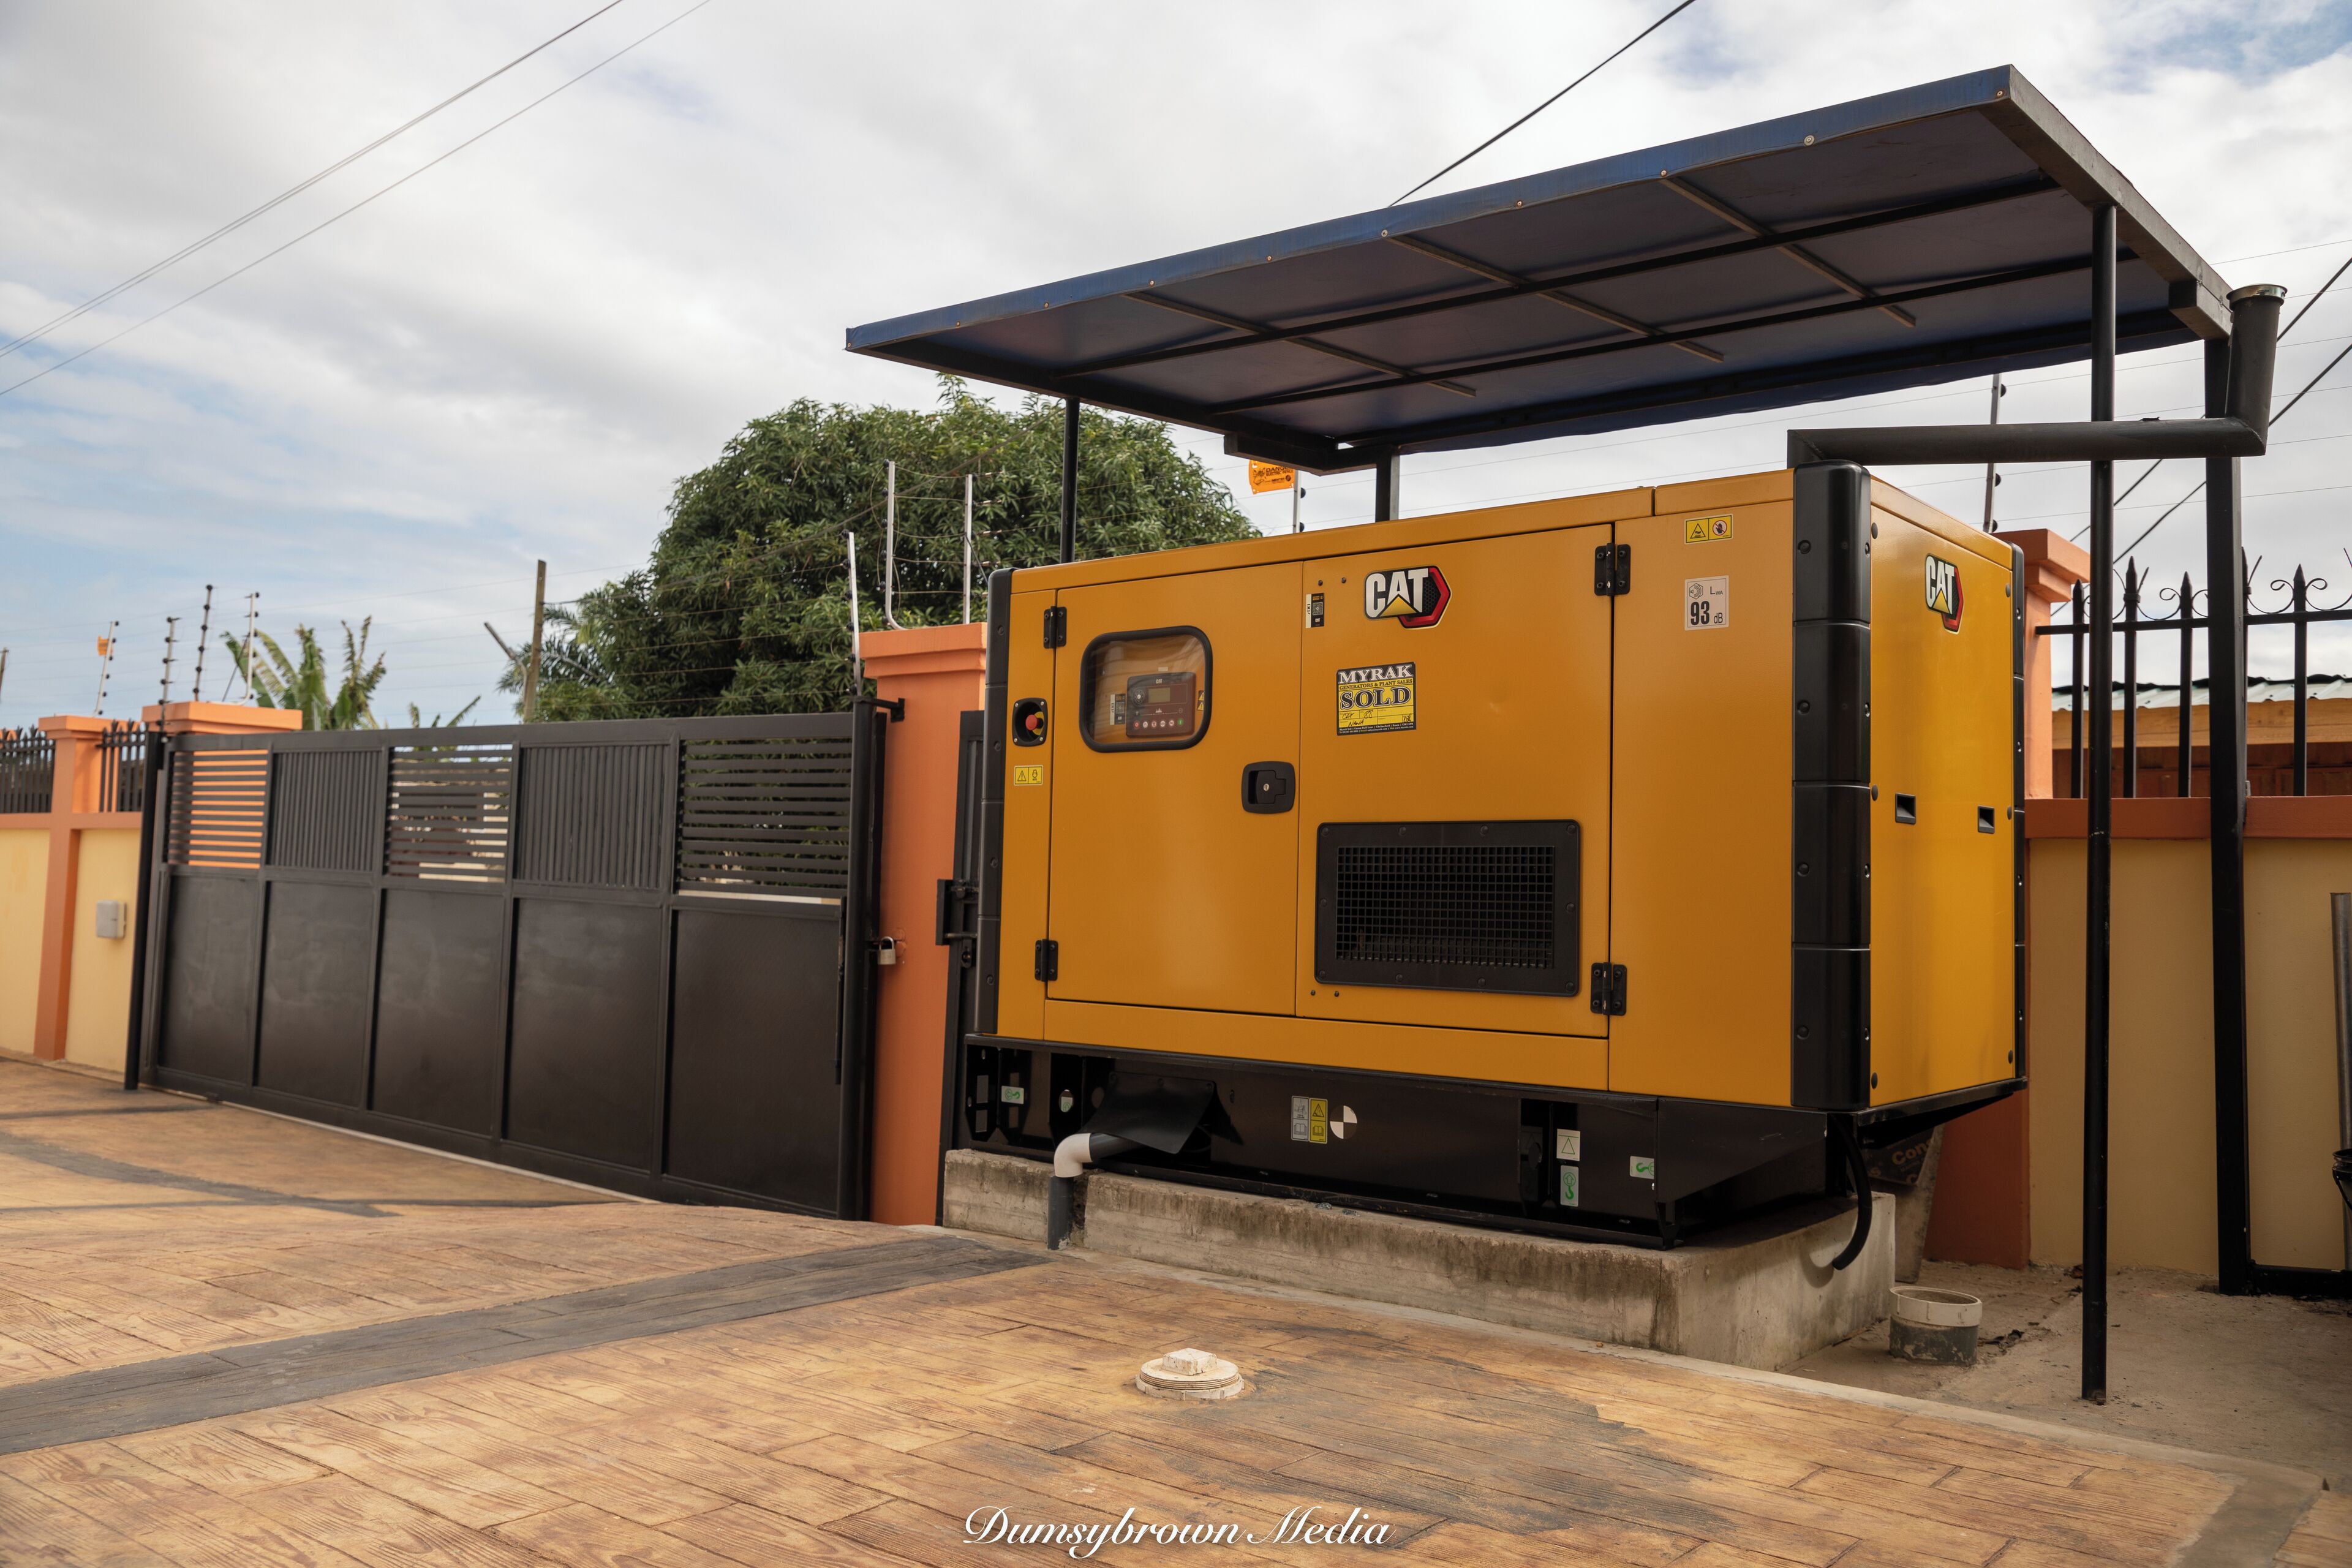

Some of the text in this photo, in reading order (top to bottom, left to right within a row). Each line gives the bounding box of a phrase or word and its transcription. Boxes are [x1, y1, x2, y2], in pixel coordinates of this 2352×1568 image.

[1365, 568, 1428, 617] CAT
[1926, 556, 1954, 614] CAT
[1691, 601, 1723, 625] 93 dB
[1339, 665, 1412, 684] MYRAK
[1340, 686, 1411, 709] SOLD
